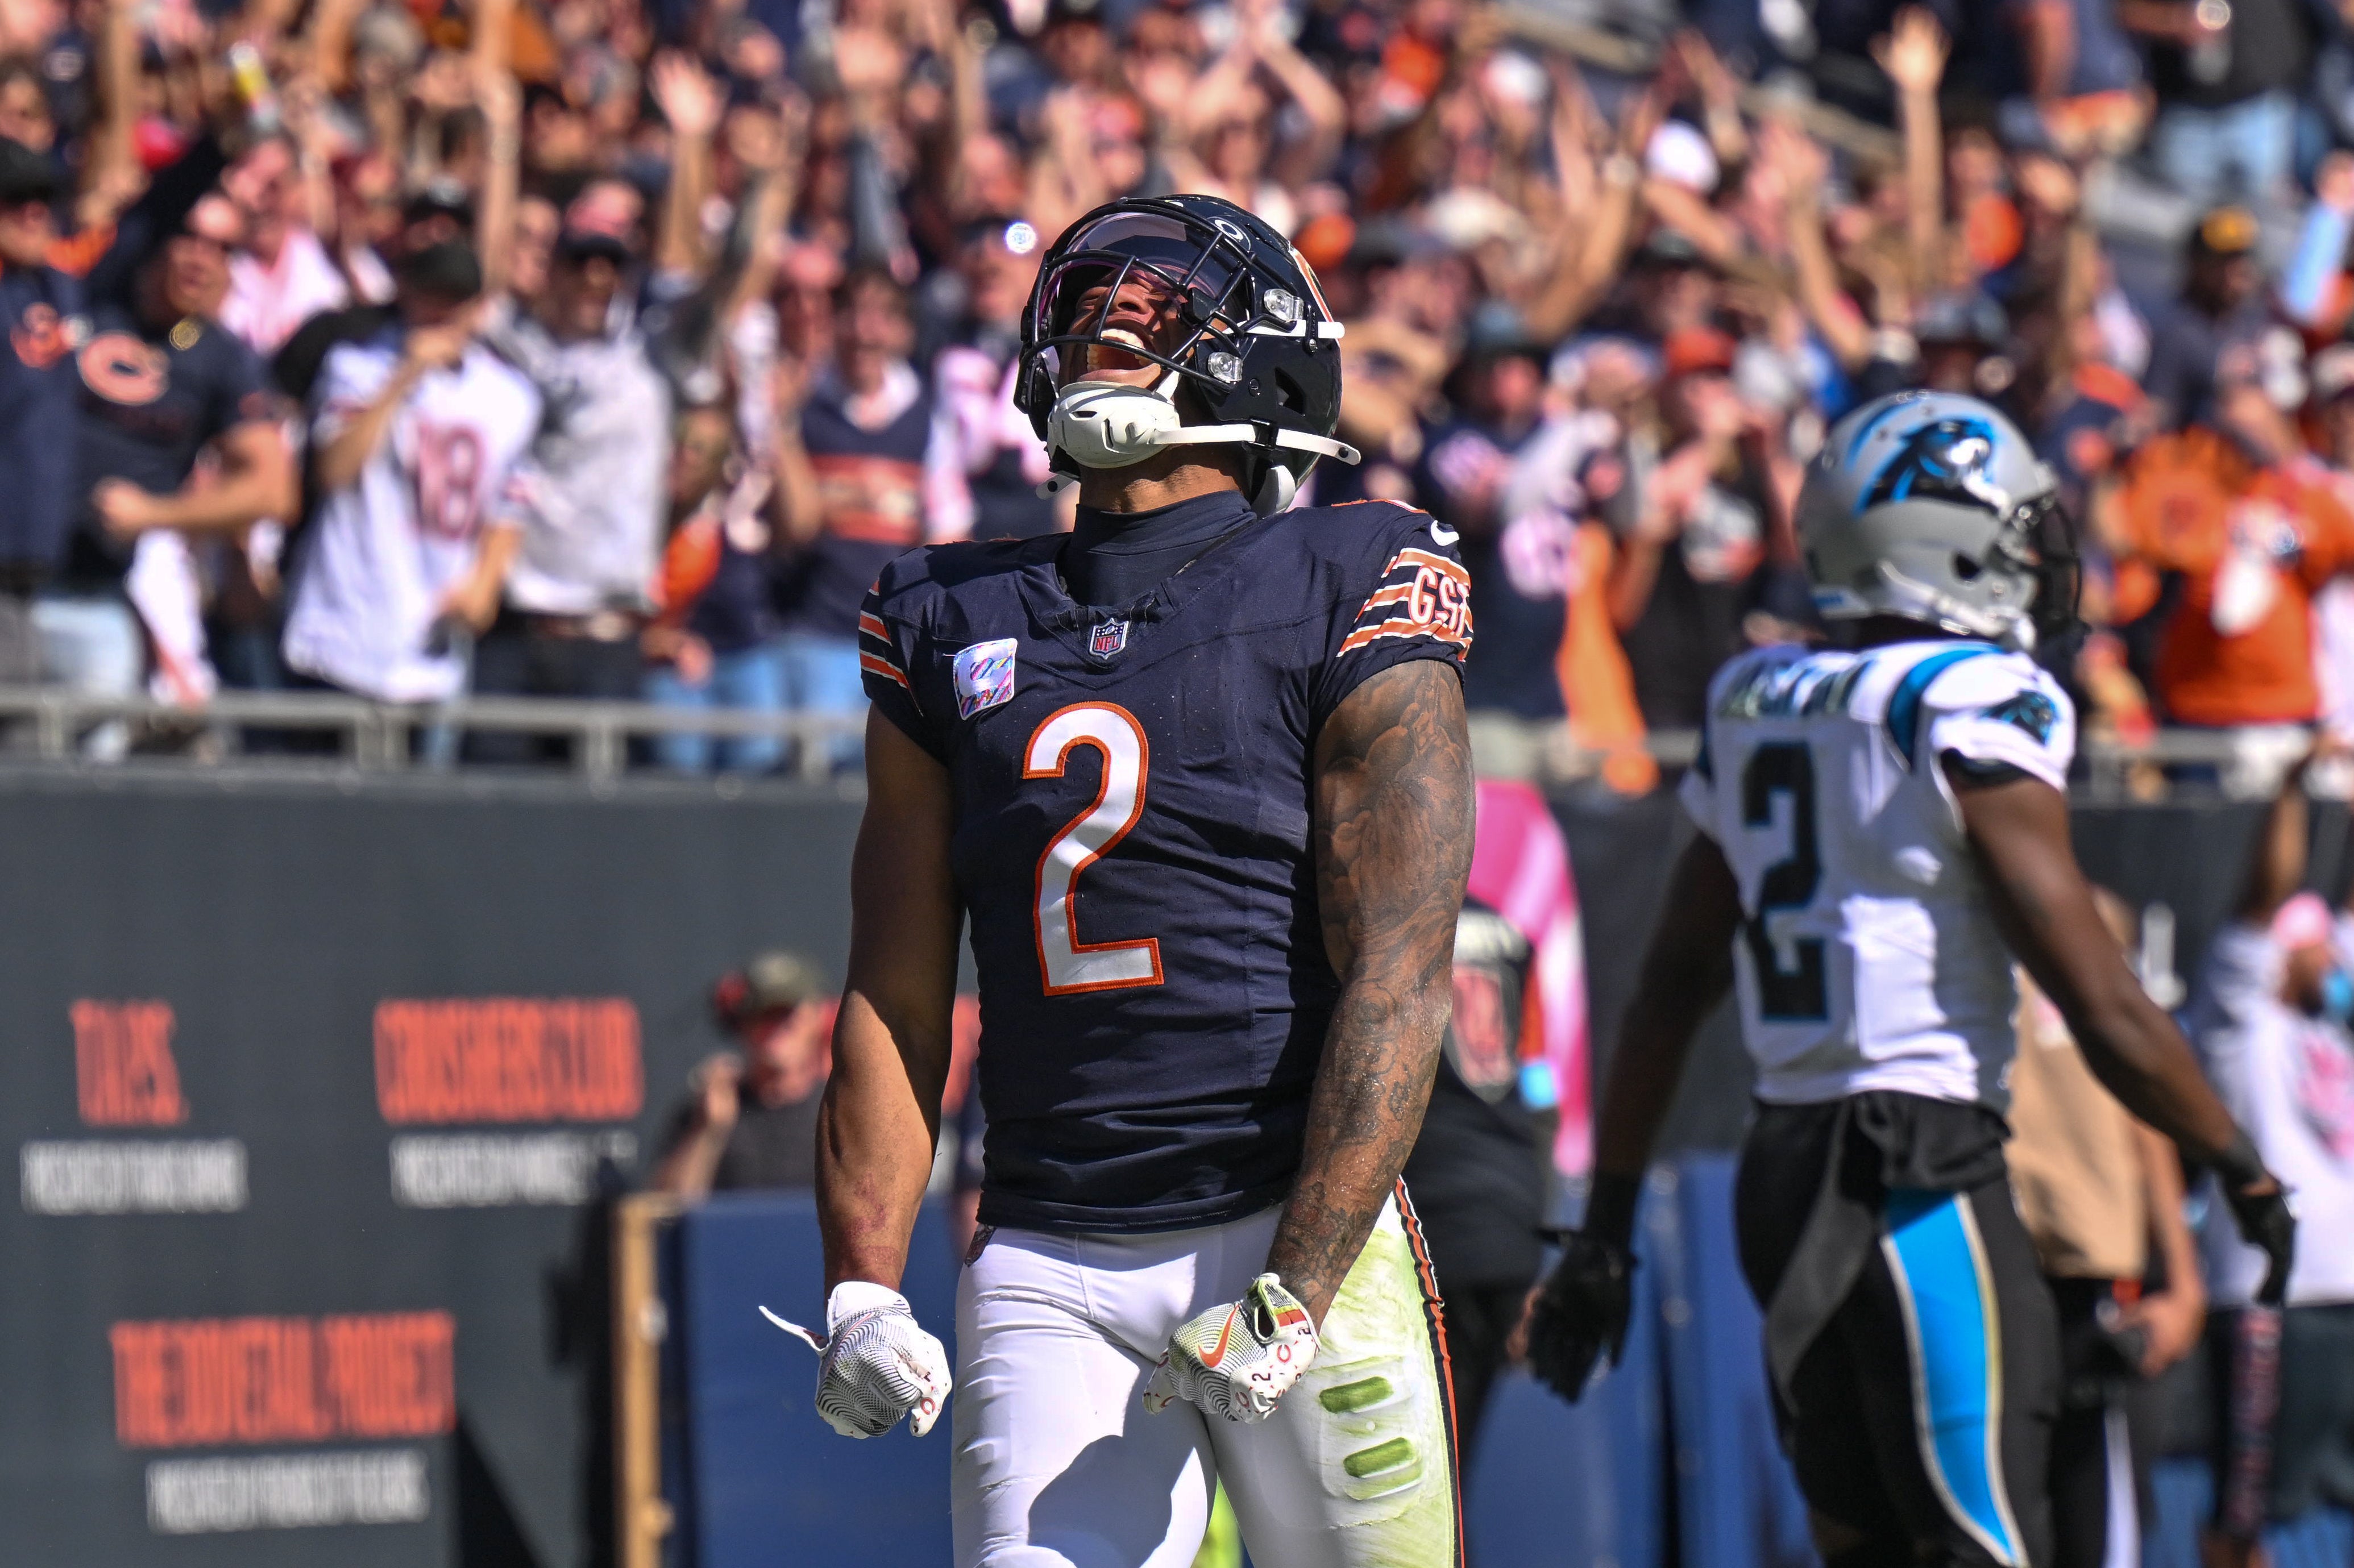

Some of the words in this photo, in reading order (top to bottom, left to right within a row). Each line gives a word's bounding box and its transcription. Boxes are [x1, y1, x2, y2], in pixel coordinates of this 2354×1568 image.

[1095, 634, 1120, 652] NFL
[1023, 701, 1164, 996] 2
[1741, 740, 1832, 1025] 2
